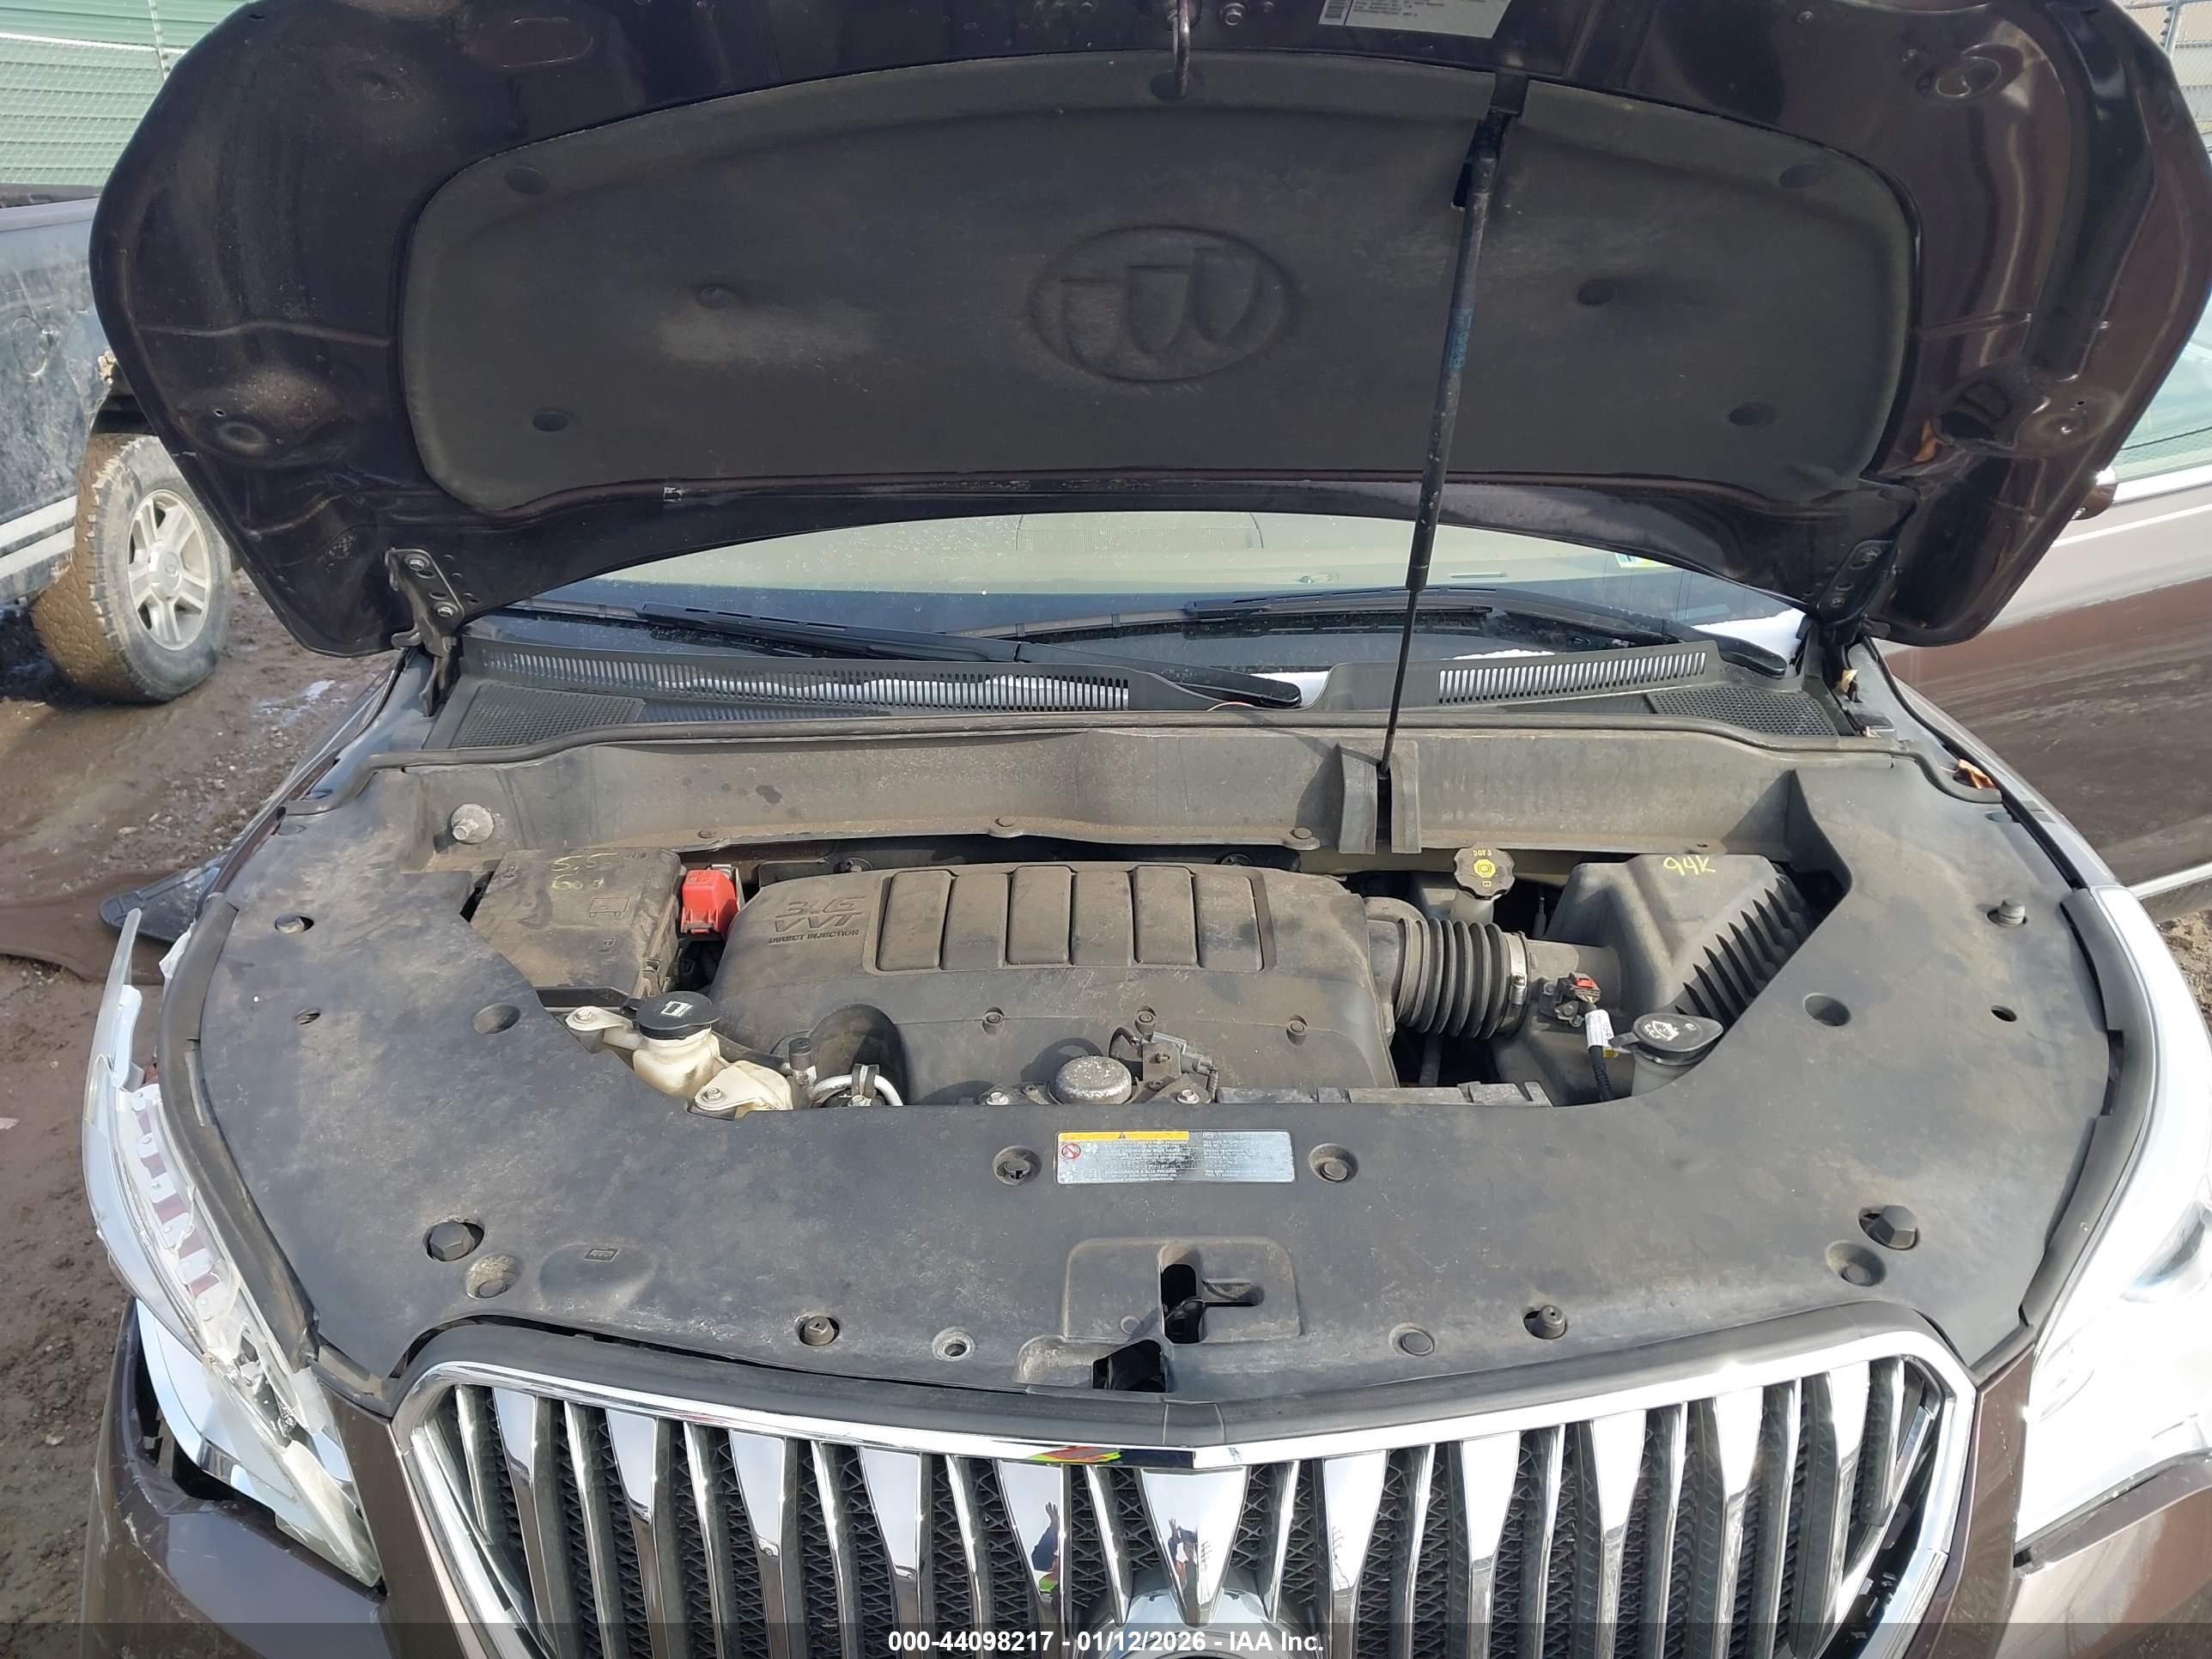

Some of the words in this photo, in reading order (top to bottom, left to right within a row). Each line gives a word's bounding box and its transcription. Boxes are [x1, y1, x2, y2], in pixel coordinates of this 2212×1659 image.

[1662, 854, 1716, 876] 94K
[769, 933, 806, 945] DIRECT
[806, 928, 860, 940] INJECTION
